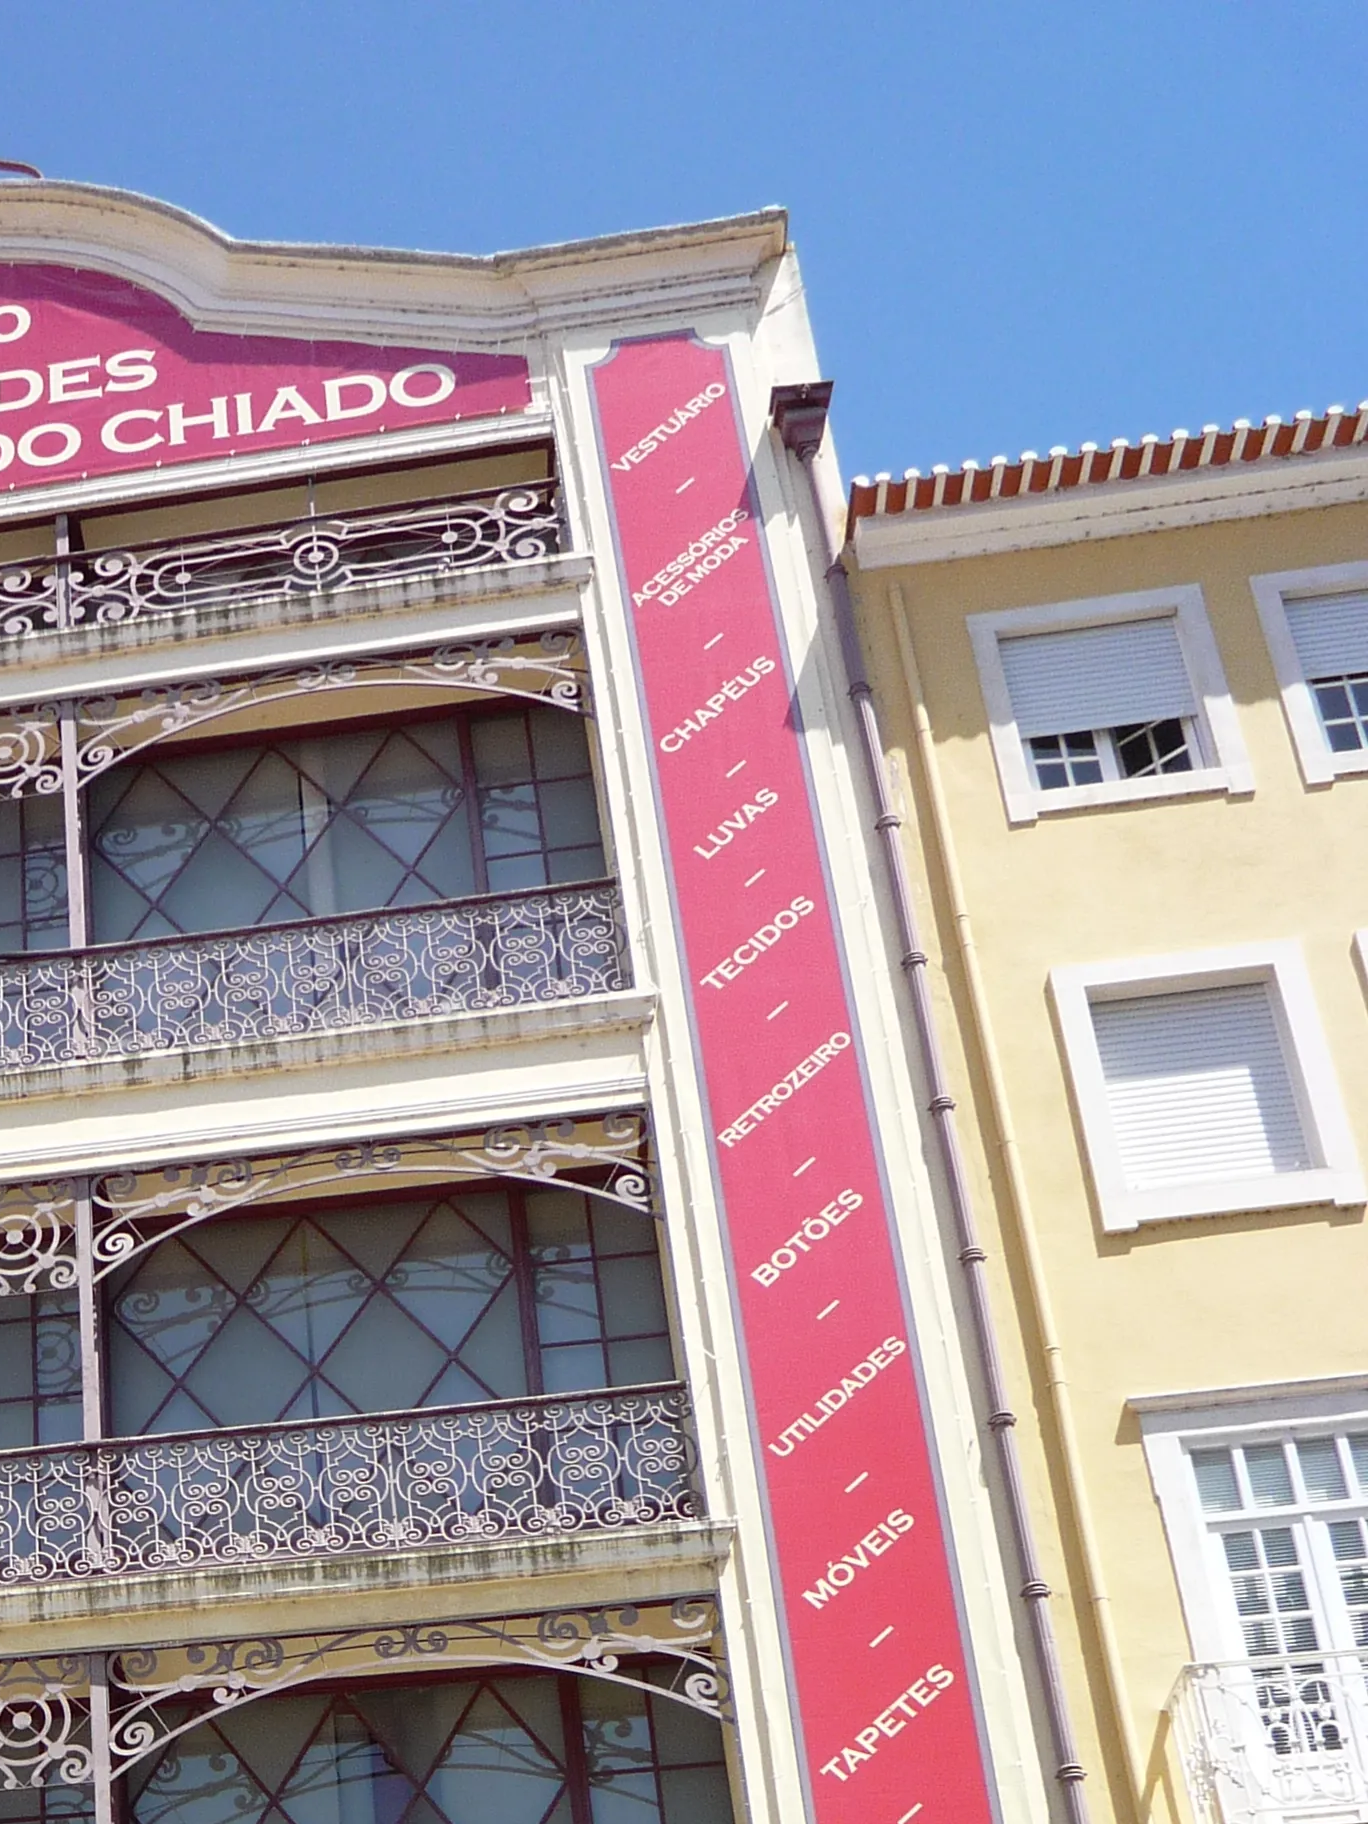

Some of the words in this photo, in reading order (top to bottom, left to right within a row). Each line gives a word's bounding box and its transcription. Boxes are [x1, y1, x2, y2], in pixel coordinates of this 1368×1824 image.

[100, 362, 457, 455] CHIADO
[611, 381, 727, 474] VESTUÁRIO
[631, 508, 750, 608] ACESSÓRIOS
[658, 583, 688, 608] DE
[685, 534, 750, 587] MODA
[659, 656, 776, 753] CHAPÉUS
[693, 788, 779, 860] LUVAS
[699, 896, 815, 990] TECIDOS
[717, 1031, 851, 1148] RETROZEIRO
[751, 1188, 863, 1288] BOTÕES
[768, 1335, 906, 1457] UTILIDADES
[801, 1508, 915, 1610] MÓVEIS
[820, 1664, 954, 1782] TAPETES
